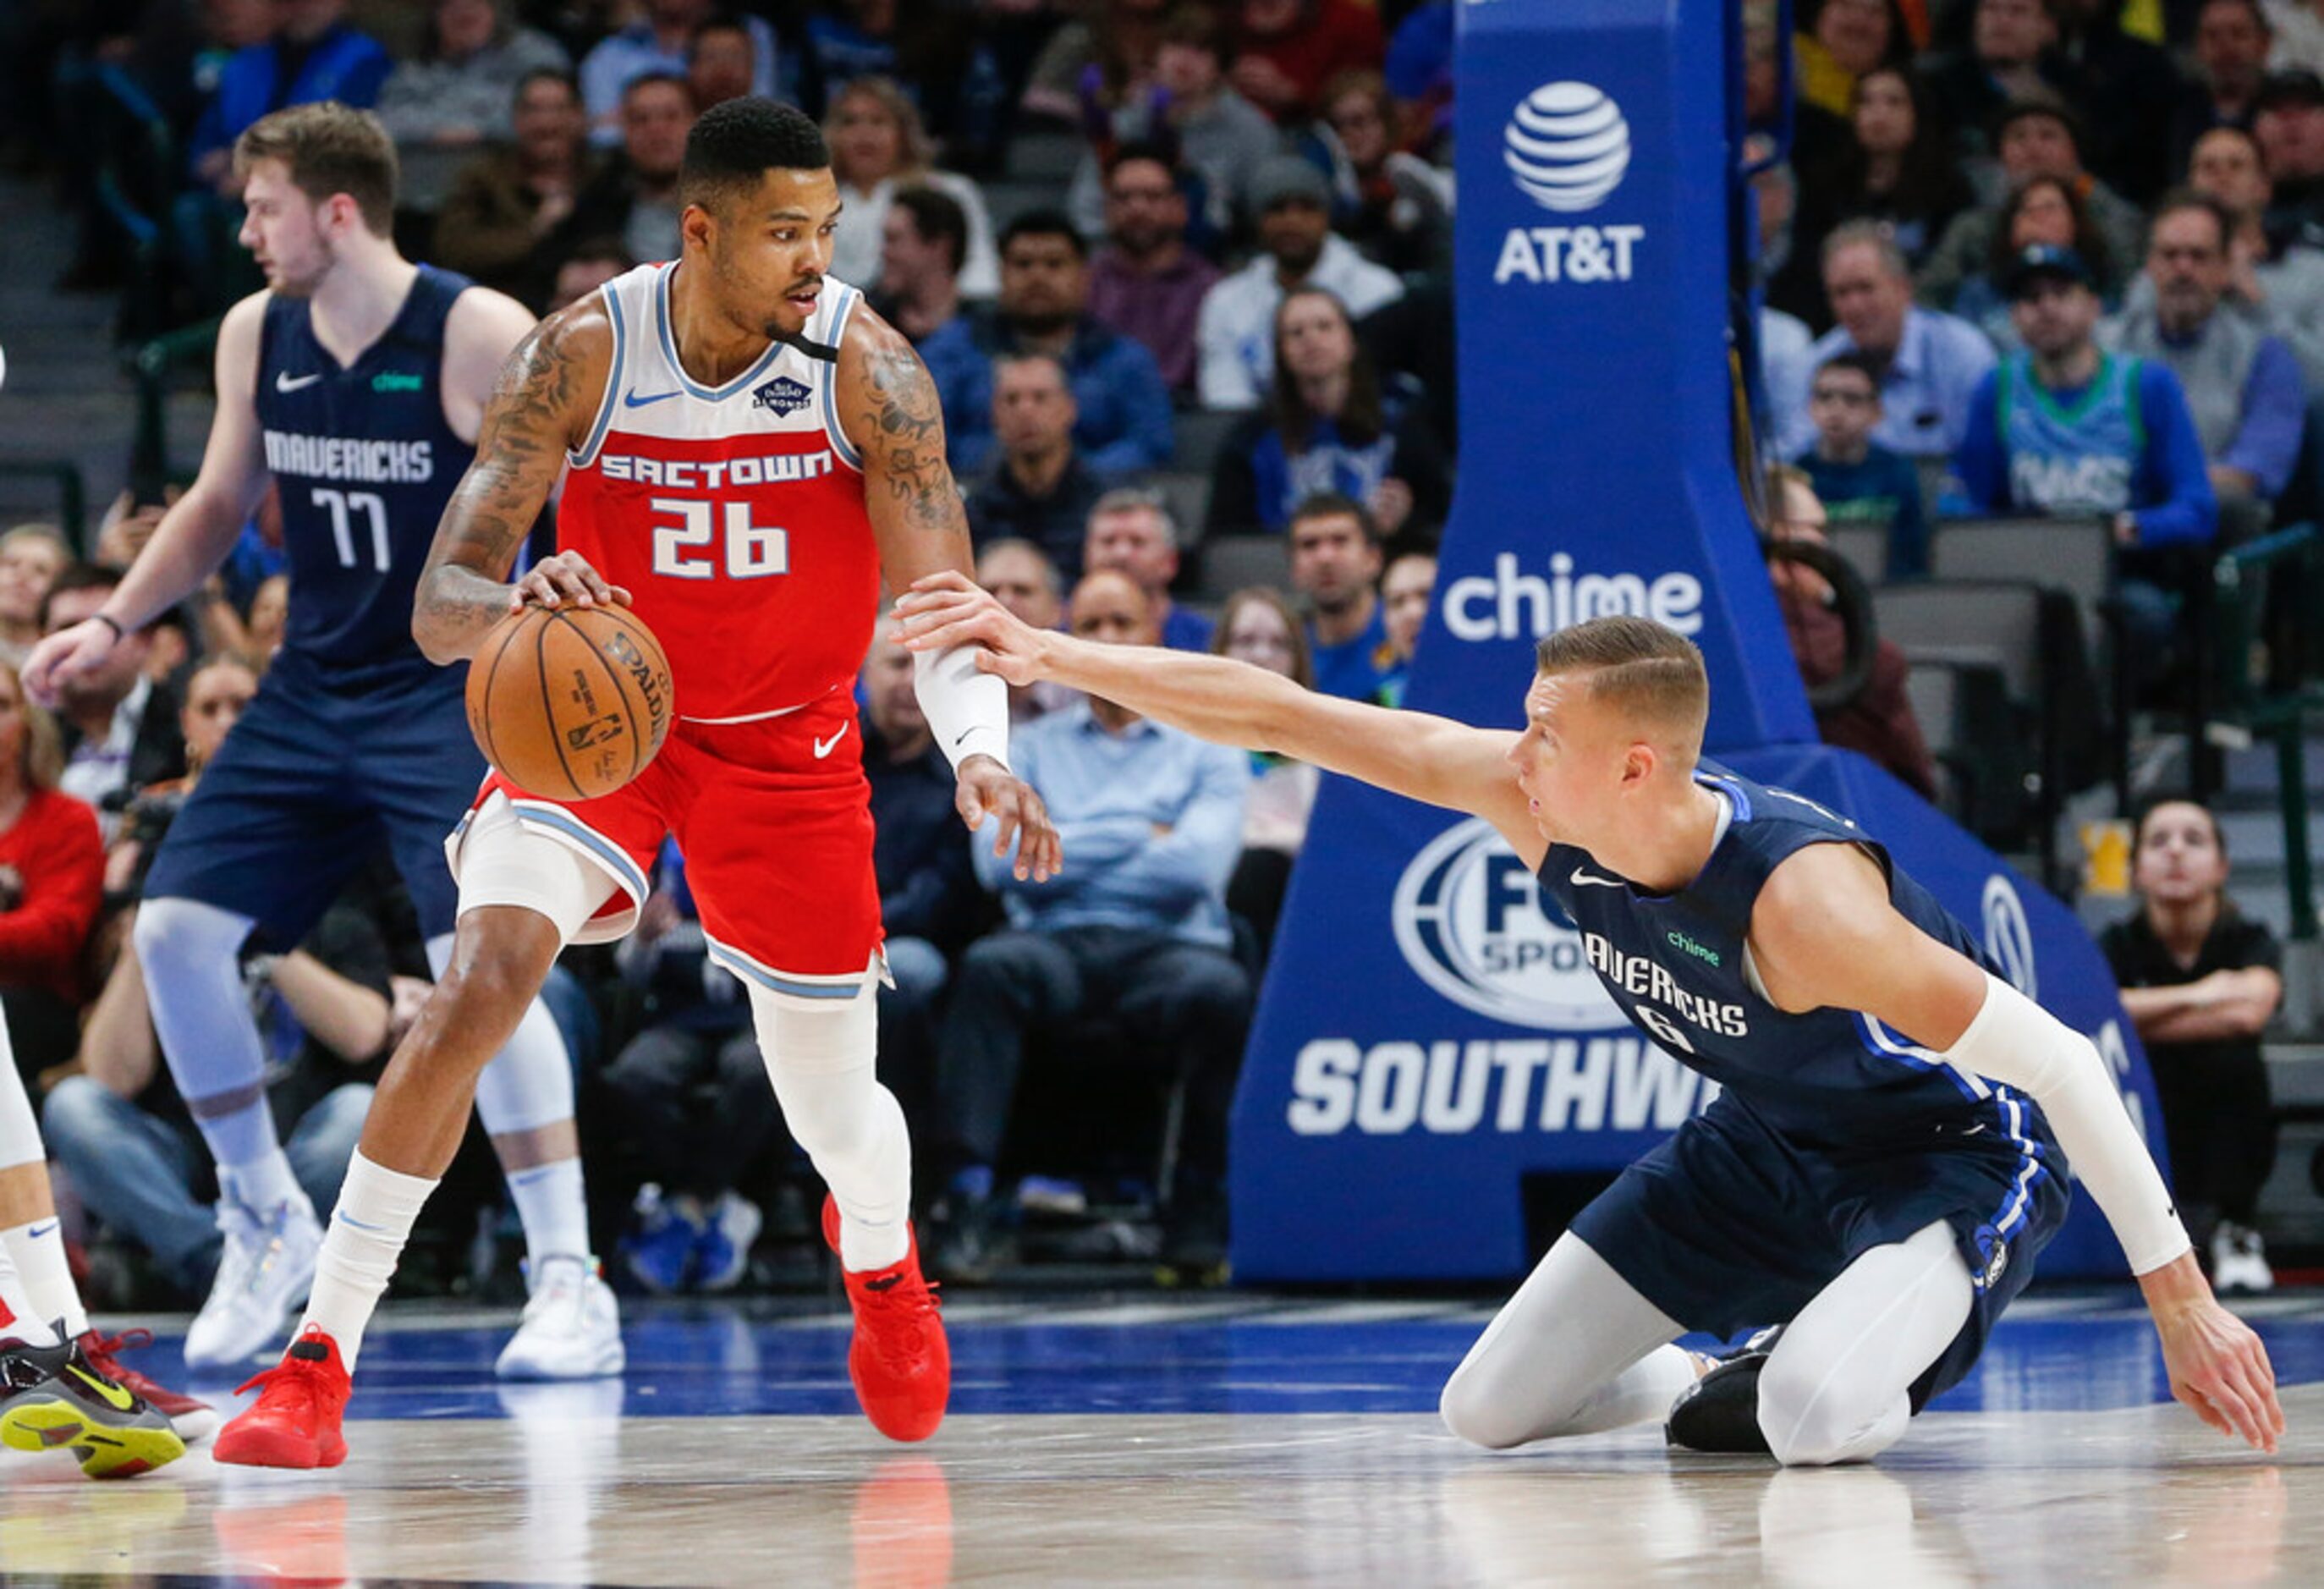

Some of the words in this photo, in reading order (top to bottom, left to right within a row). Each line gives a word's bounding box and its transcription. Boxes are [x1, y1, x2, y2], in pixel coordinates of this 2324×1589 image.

[1493, 225, 1645, 283] AT&T
[264, 430, 434, 483] MAVERICKS
[601, 448, 833, 489] SACTOWN
[310, 487, 390, 572] 77
[650, 497, 789, 579] 26
[1442, 552, 1703, 641] chime
[1667, 931, 1721, 968] chime
[1634, 1004, 1695, 1054] 6
[1286, 1037, 1723, 1135] SOUTHW
